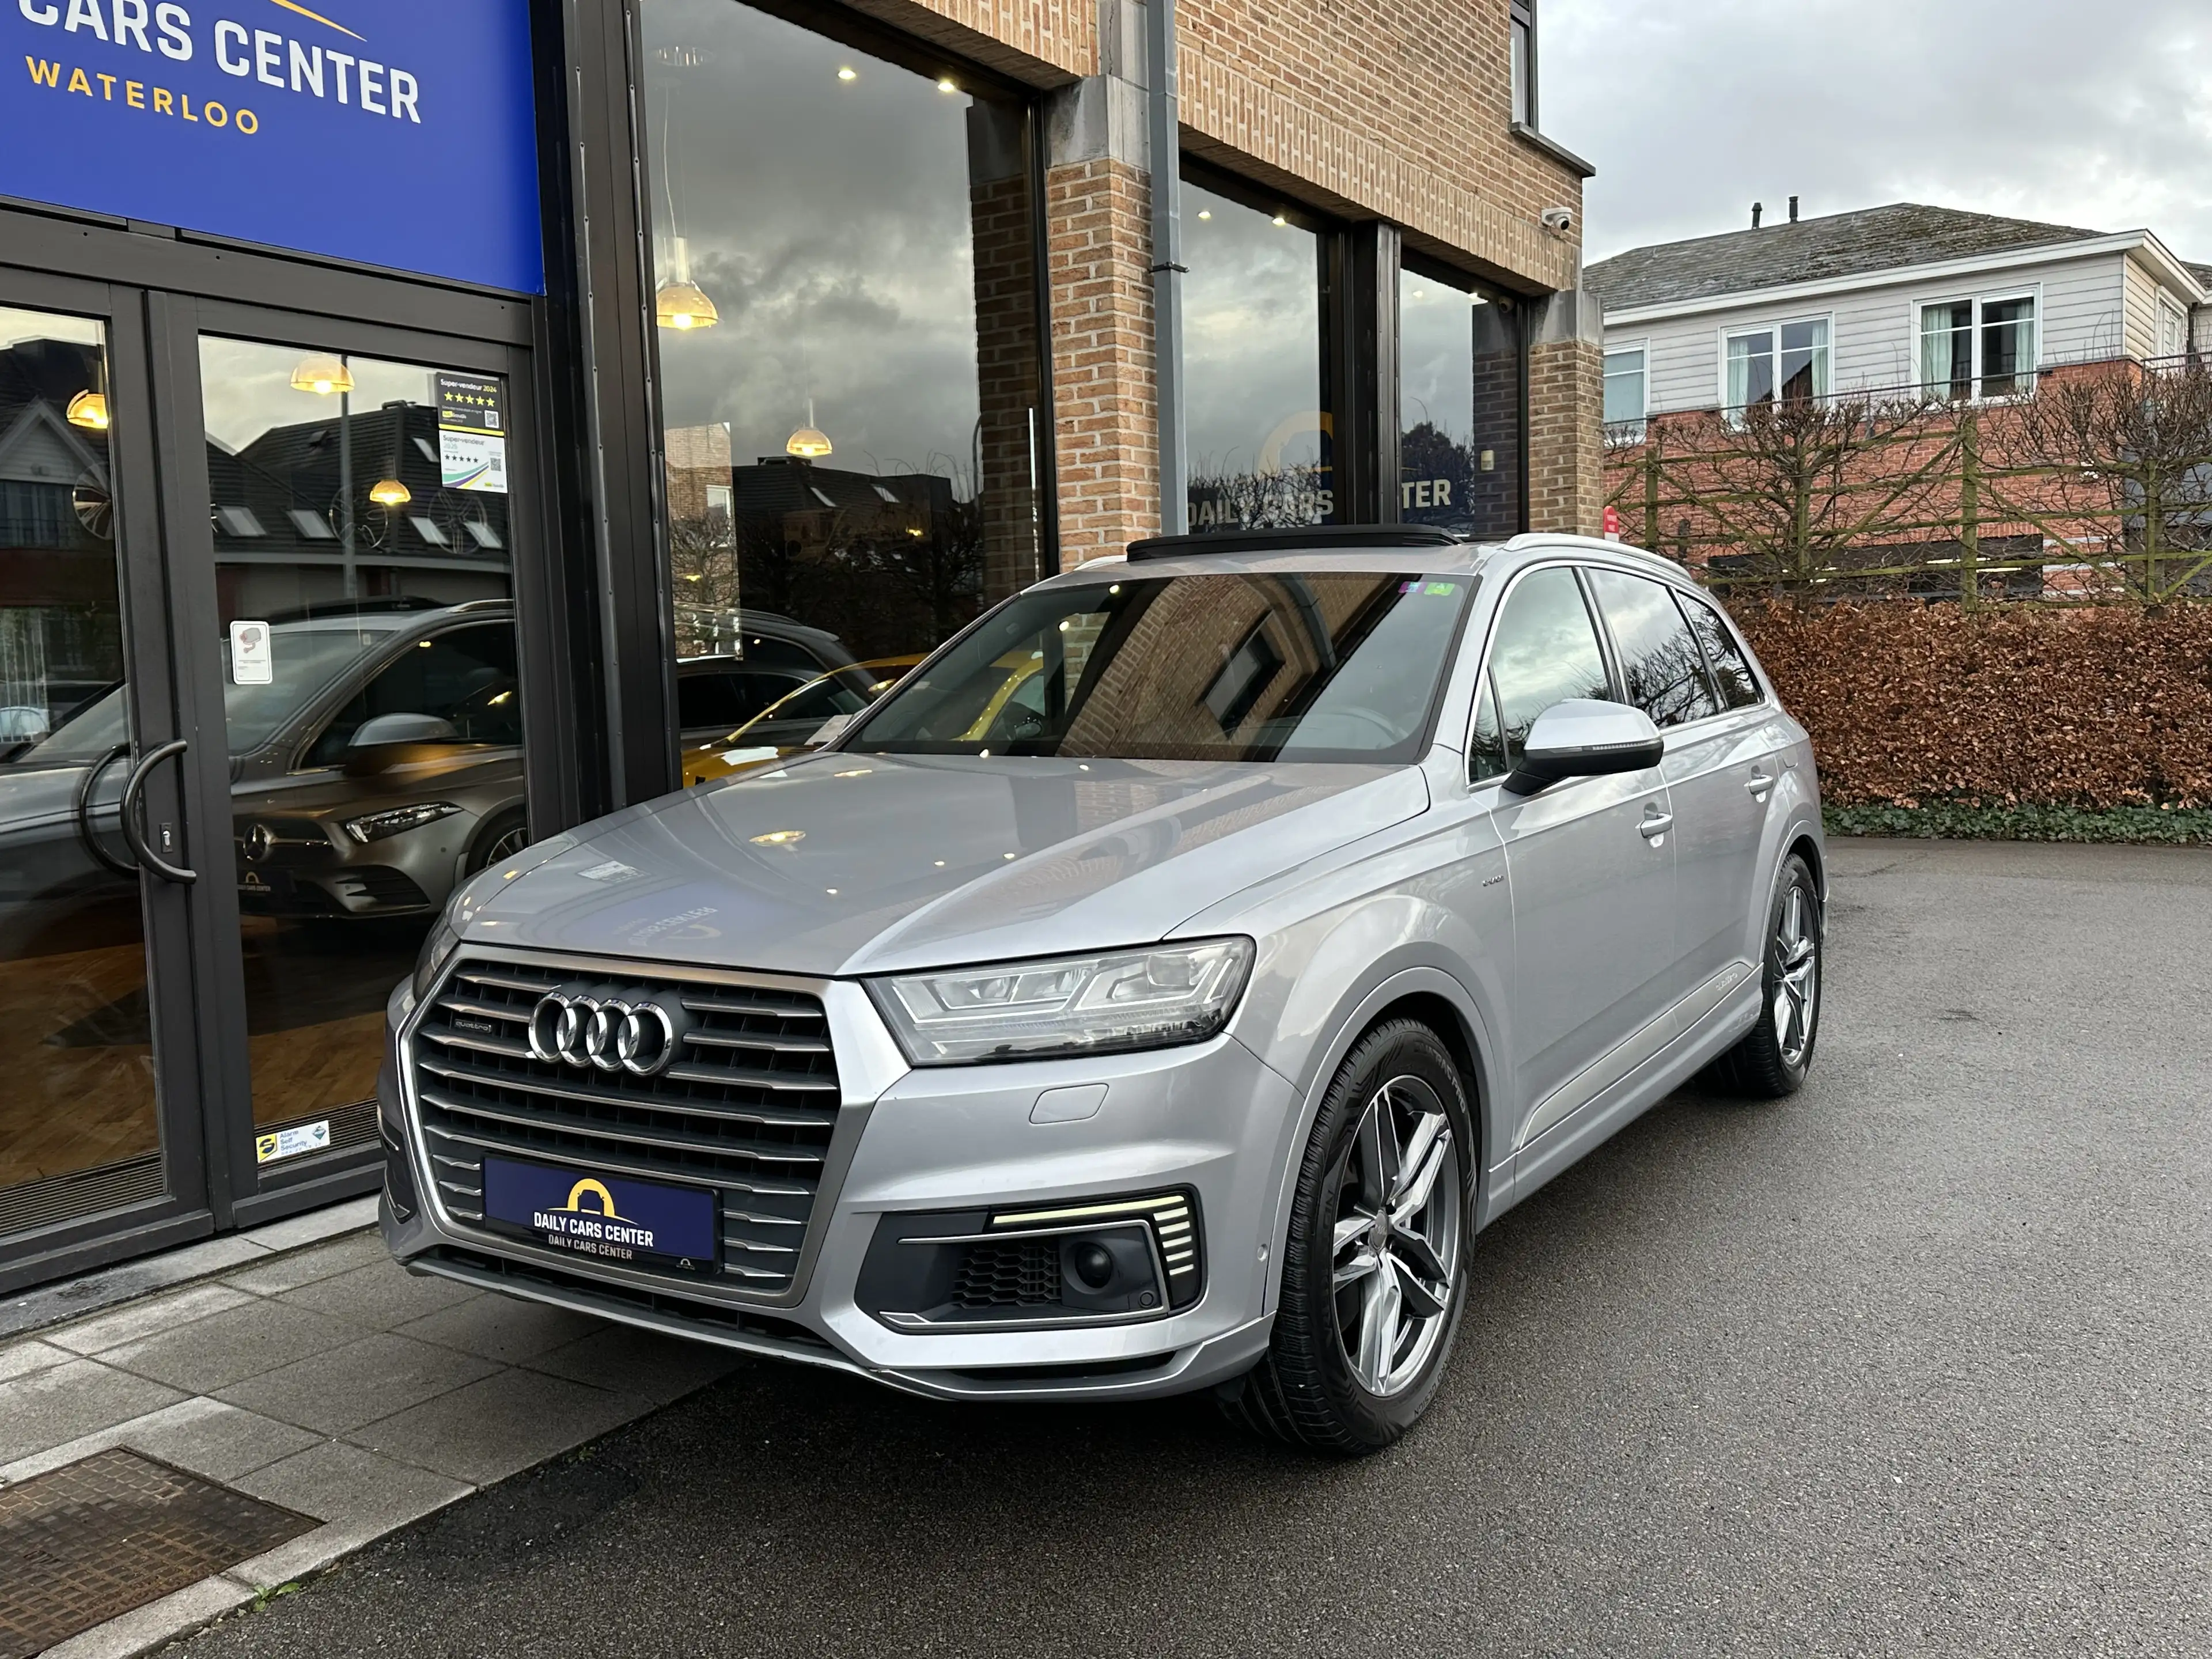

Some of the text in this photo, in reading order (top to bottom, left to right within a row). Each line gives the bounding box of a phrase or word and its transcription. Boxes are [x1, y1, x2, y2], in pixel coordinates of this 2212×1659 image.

[215, 19, 421, 123] CENTER
[25, 55, 258, 134] WATERLOO
[440, 378, 497, 393] Super-vendeur 2024
[442, 435, 485, 445] Super-vendeur
[1188, 499, 1256, 527] DAIL
[1402, 479, 1451, 509] TER
[455, 1021, 488, 1031] quattro
[1452, 1076, 1466, 1113] PRO
[280, 1130, 299, 1138] Alarm
[281, 1141, 308, 1151] Security
[533, 1211, 654, 1247] DAILY CARS CENTER
[548, 1234, 632, 1260] DAILY CARS CENTER
